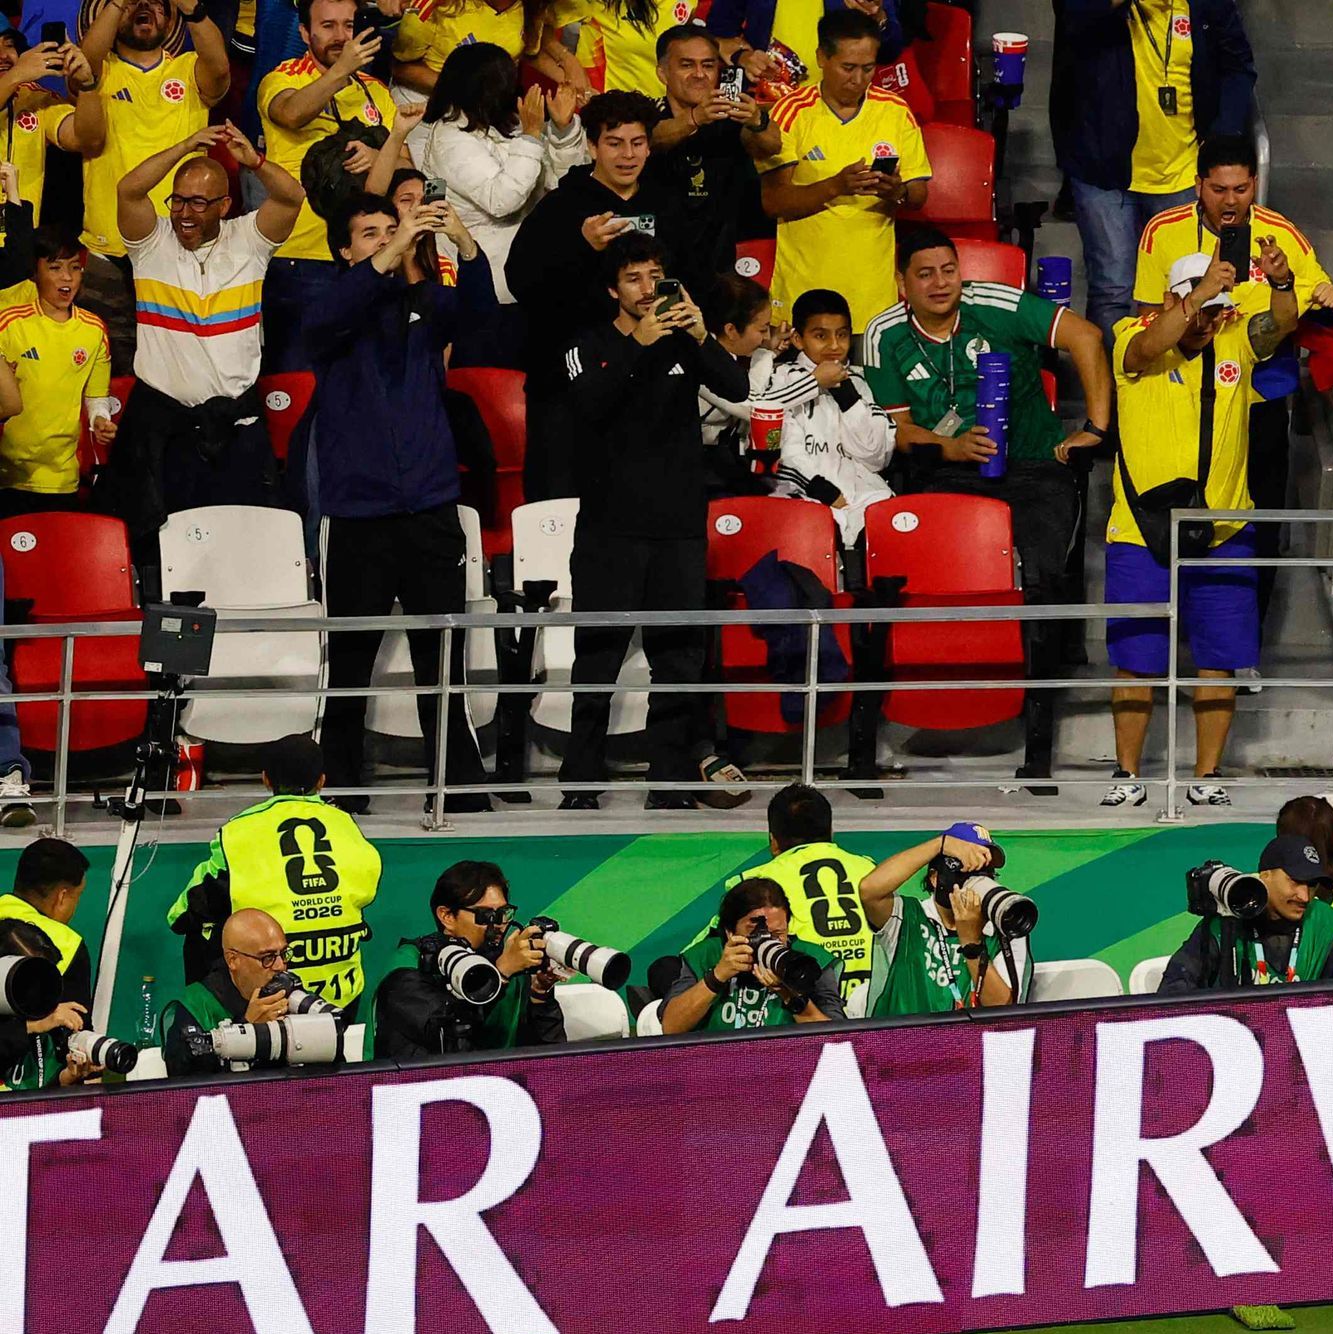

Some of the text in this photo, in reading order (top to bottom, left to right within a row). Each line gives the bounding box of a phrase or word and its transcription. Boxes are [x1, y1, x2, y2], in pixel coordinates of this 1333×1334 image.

[301, 877, 327, 888] FIFA
[292, 895, 342, 907] WORLD CUP
[293, 905, 343, 921] 2026
[827, 919, 851, 931] FIFA
[287, 927, 369, 963] CURITY
[847, 939, 866, 947] CUP
[832, 949, 866, 961] 026
[307, 971, 357, 1000] 711
